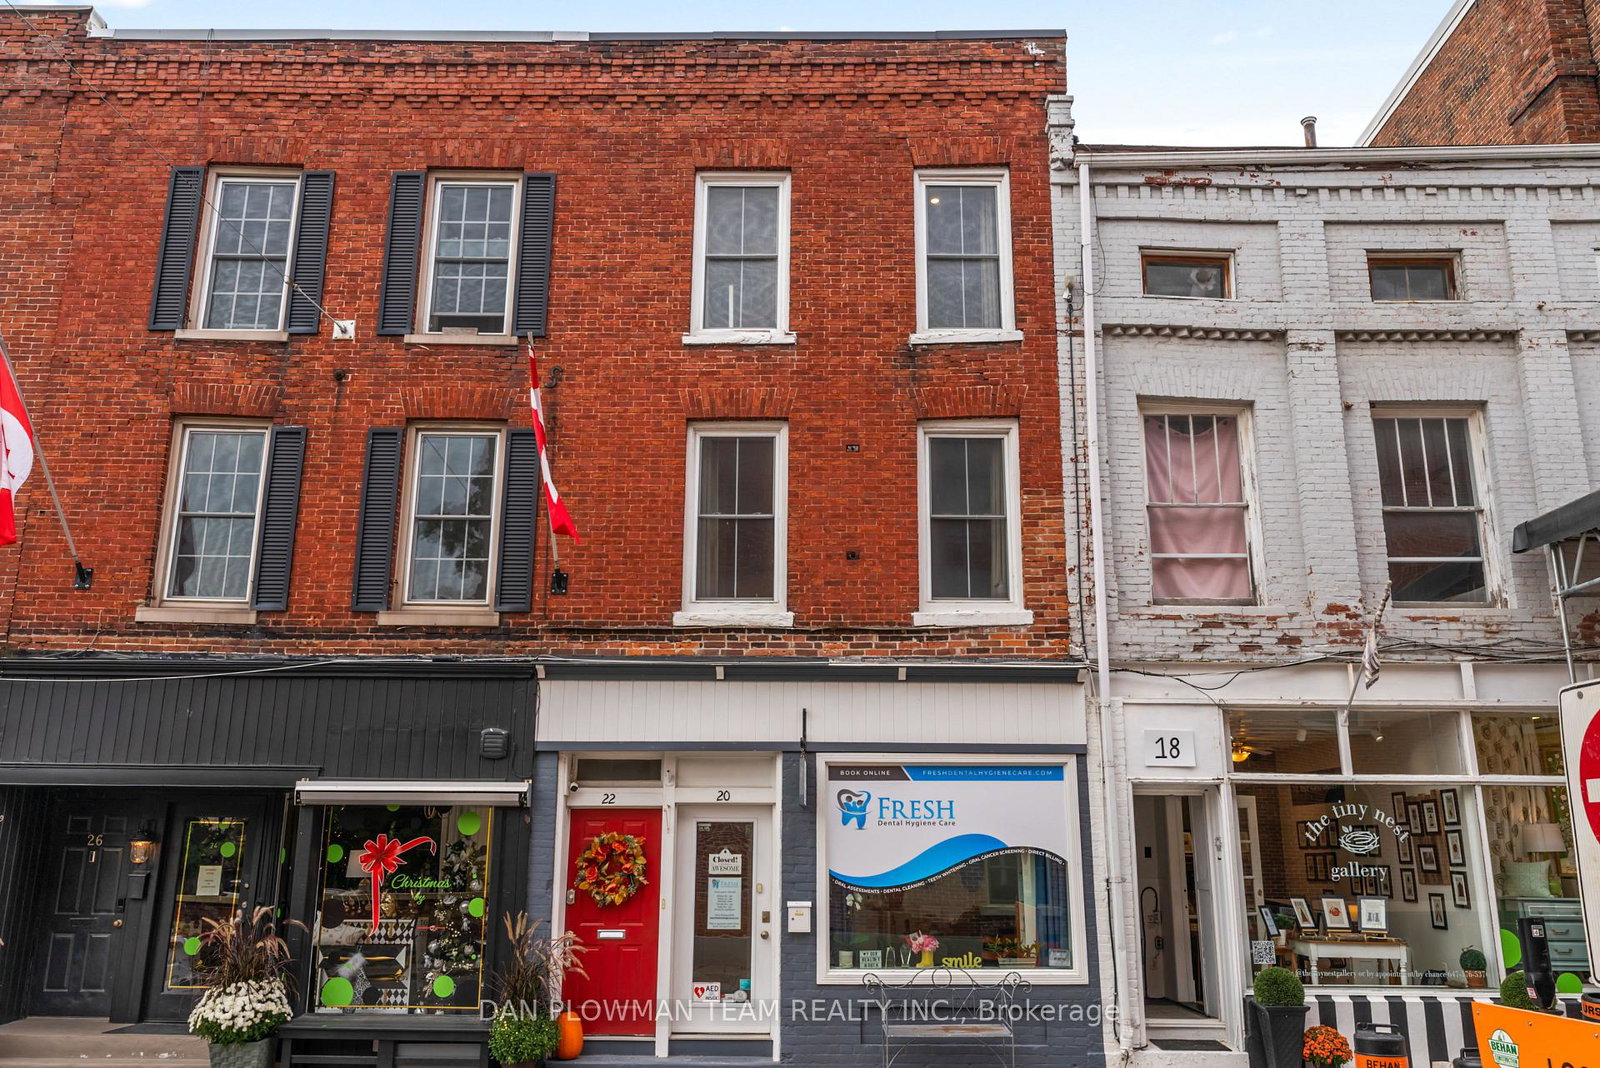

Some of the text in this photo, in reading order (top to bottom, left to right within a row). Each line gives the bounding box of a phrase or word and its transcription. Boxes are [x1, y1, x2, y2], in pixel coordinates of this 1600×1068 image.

[1155, 737, 1180, 758] 18
[601, 793, 616, 804] 22
[716, 790, 730, 801] 20
[878, 797, 955, 819] FRESH
[905, 820, 936, 828] Hygiene
[1305, 800, 1409, 843] the tiny nest
[87, 834, 103, 846] 26
[847, 885, 880, 893] ASSESSMENTS
[902, 880, 925, 890] CLEANING
[928, 874, 942, 883] TEETH
[942, 863, 966, 876] WHITENING
[969, 857, 981, 865] ORAL
[981, 851, 999, 860] CANCER
[1045, 853, 1062, 865] BILLING
[1331, 861, 1388, 881] gallery
[391, 874, 451, 889] Christmas
[413, 890, 425, 905] by
[942, 951, 982, 968] smile
[1490, 1041, 1517, 1055] BEHAN
